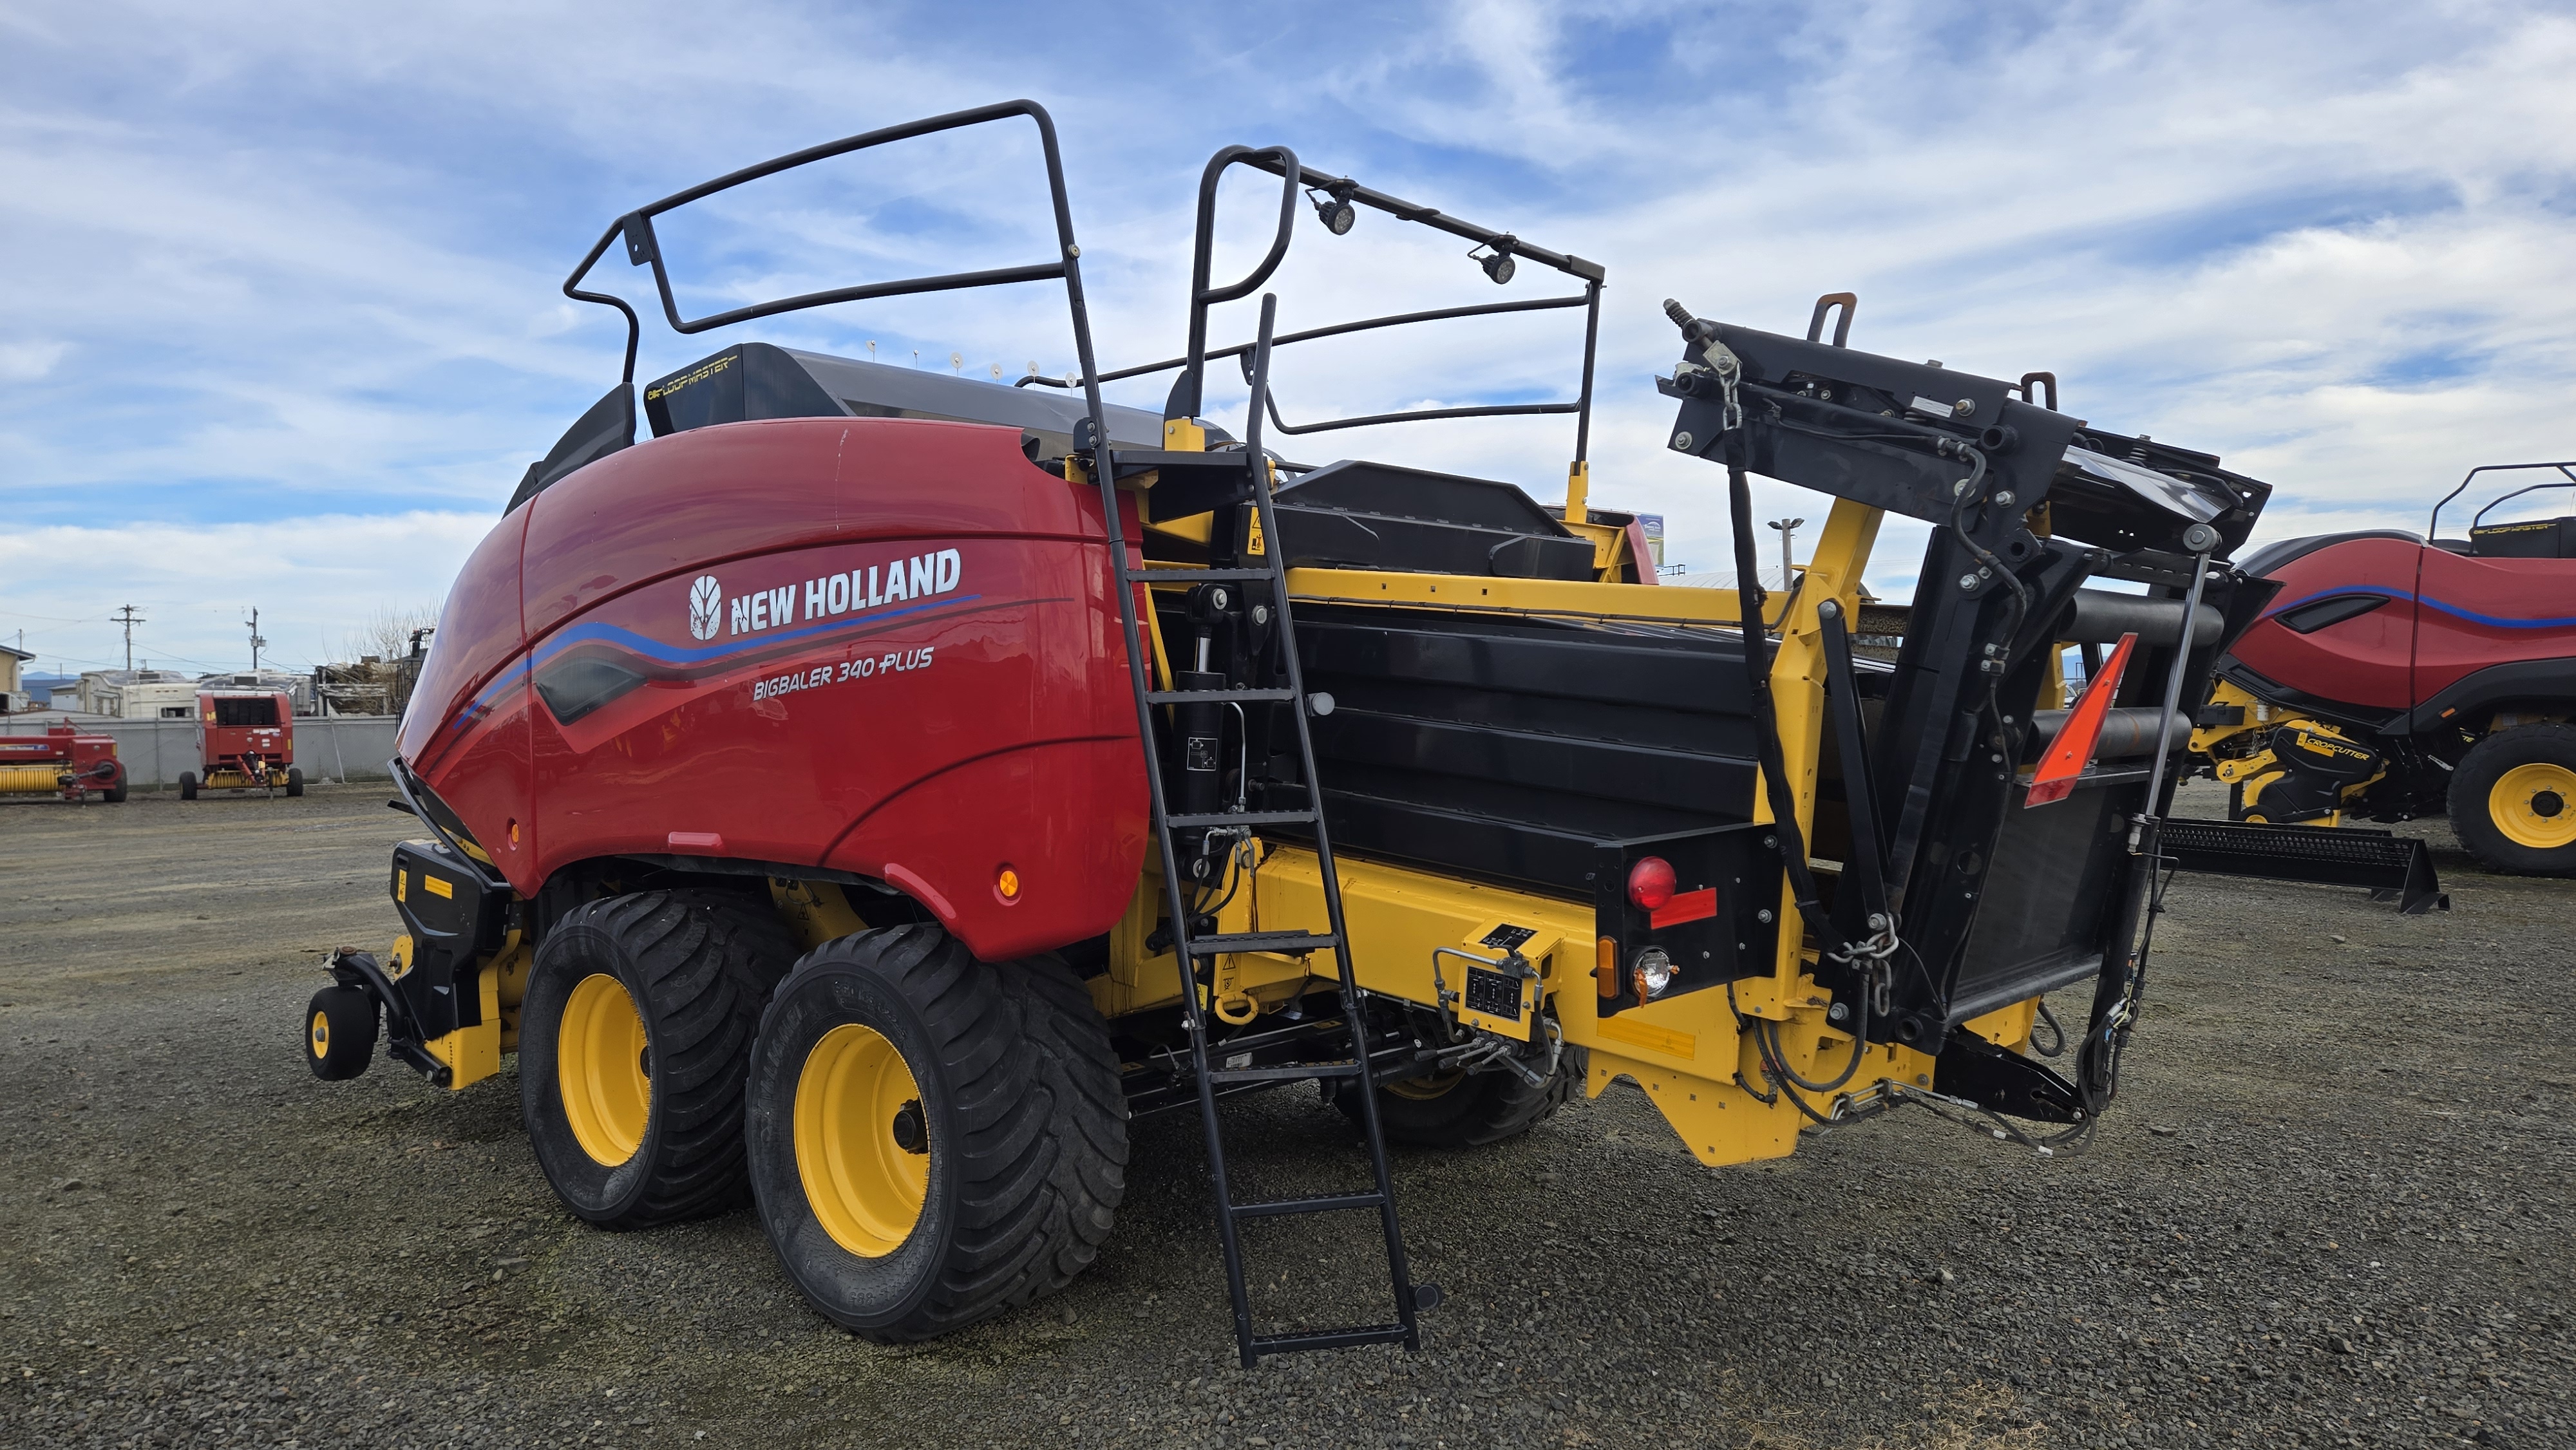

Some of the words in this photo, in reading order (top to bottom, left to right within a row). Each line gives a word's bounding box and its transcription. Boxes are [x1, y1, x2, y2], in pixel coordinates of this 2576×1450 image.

[731, 584, 797, 636] NEW
[804, 547, 961, 620] HOLLAND
[753, 666, 832, 701] BIGBALER
[837, 657, 875, 683] 340
[2307, 738, 2370, 760] CROPCUTTER
